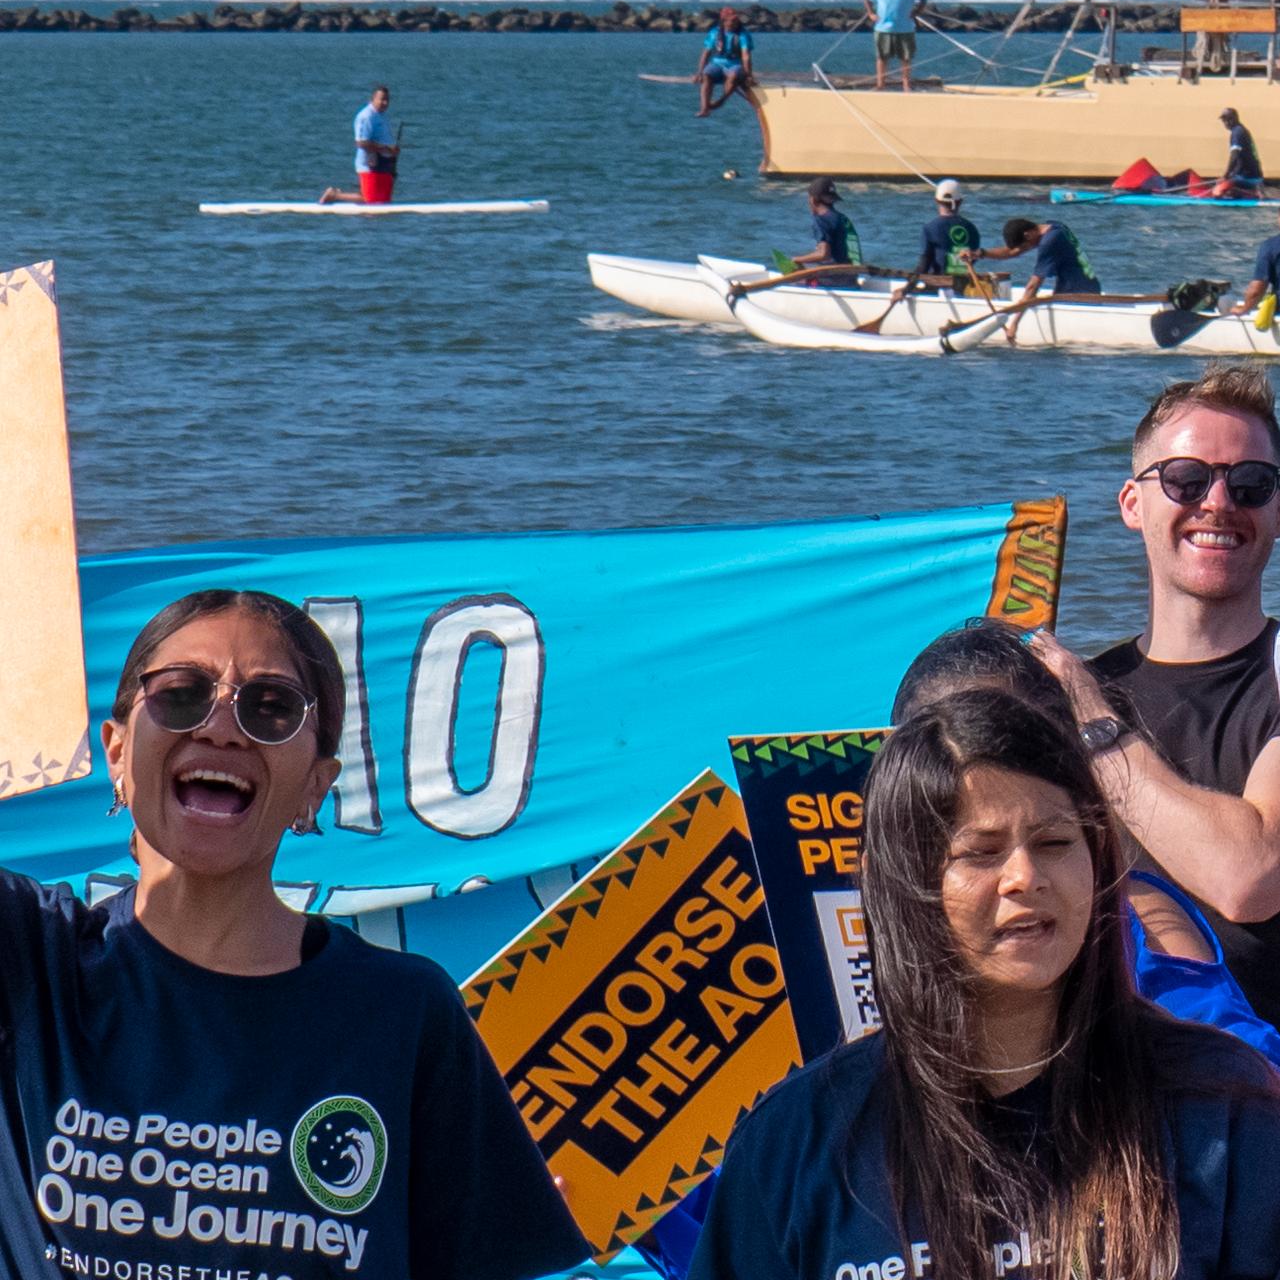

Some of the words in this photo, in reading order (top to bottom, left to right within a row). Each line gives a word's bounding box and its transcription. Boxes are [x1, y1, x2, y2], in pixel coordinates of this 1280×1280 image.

[786, 791, 864, 831] SIG
[510, 855, 766, 1142] ENDORSE
[581, 1018, 721, 1144] THE
[699, 943, 786, 1043] AO
[46, 1135, 124, 1181] One
[130, 1148, 269, 1193] Ocean
[55, 1097, 130, 1142] One
[135, 1114, 282, 1159] People
[37, 1173, 145, 1235] One
[153, 1190, 369, 1270] Journey
